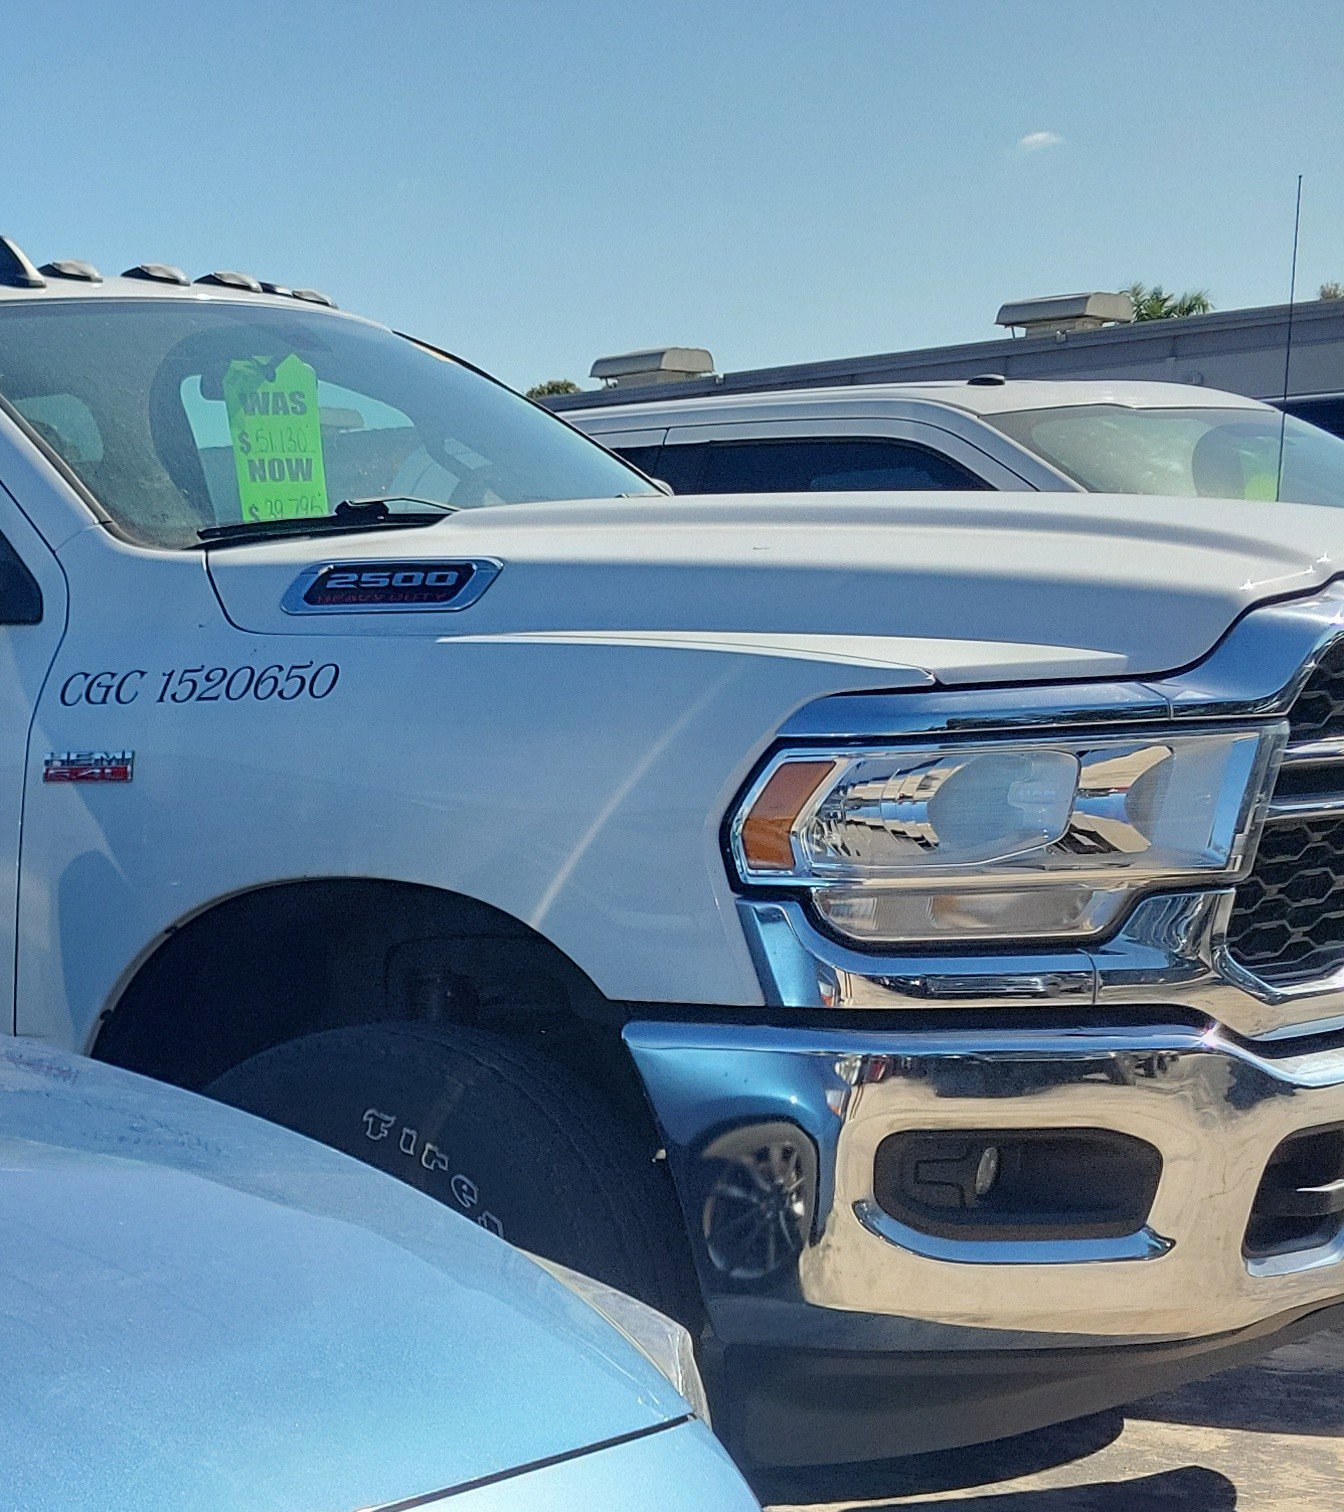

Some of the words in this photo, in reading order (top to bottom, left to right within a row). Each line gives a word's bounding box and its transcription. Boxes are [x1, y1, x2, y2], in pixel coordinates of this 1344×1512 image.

[240, 390, 308, 416] WAS
[247, 458, 313, 484] NOW
[326, 571, 459, 589] 2500
[59, 670, 147, 706] CGC
[156, 661, 340, 703] 1520650
[43, 751, 135, 766] HEMI
